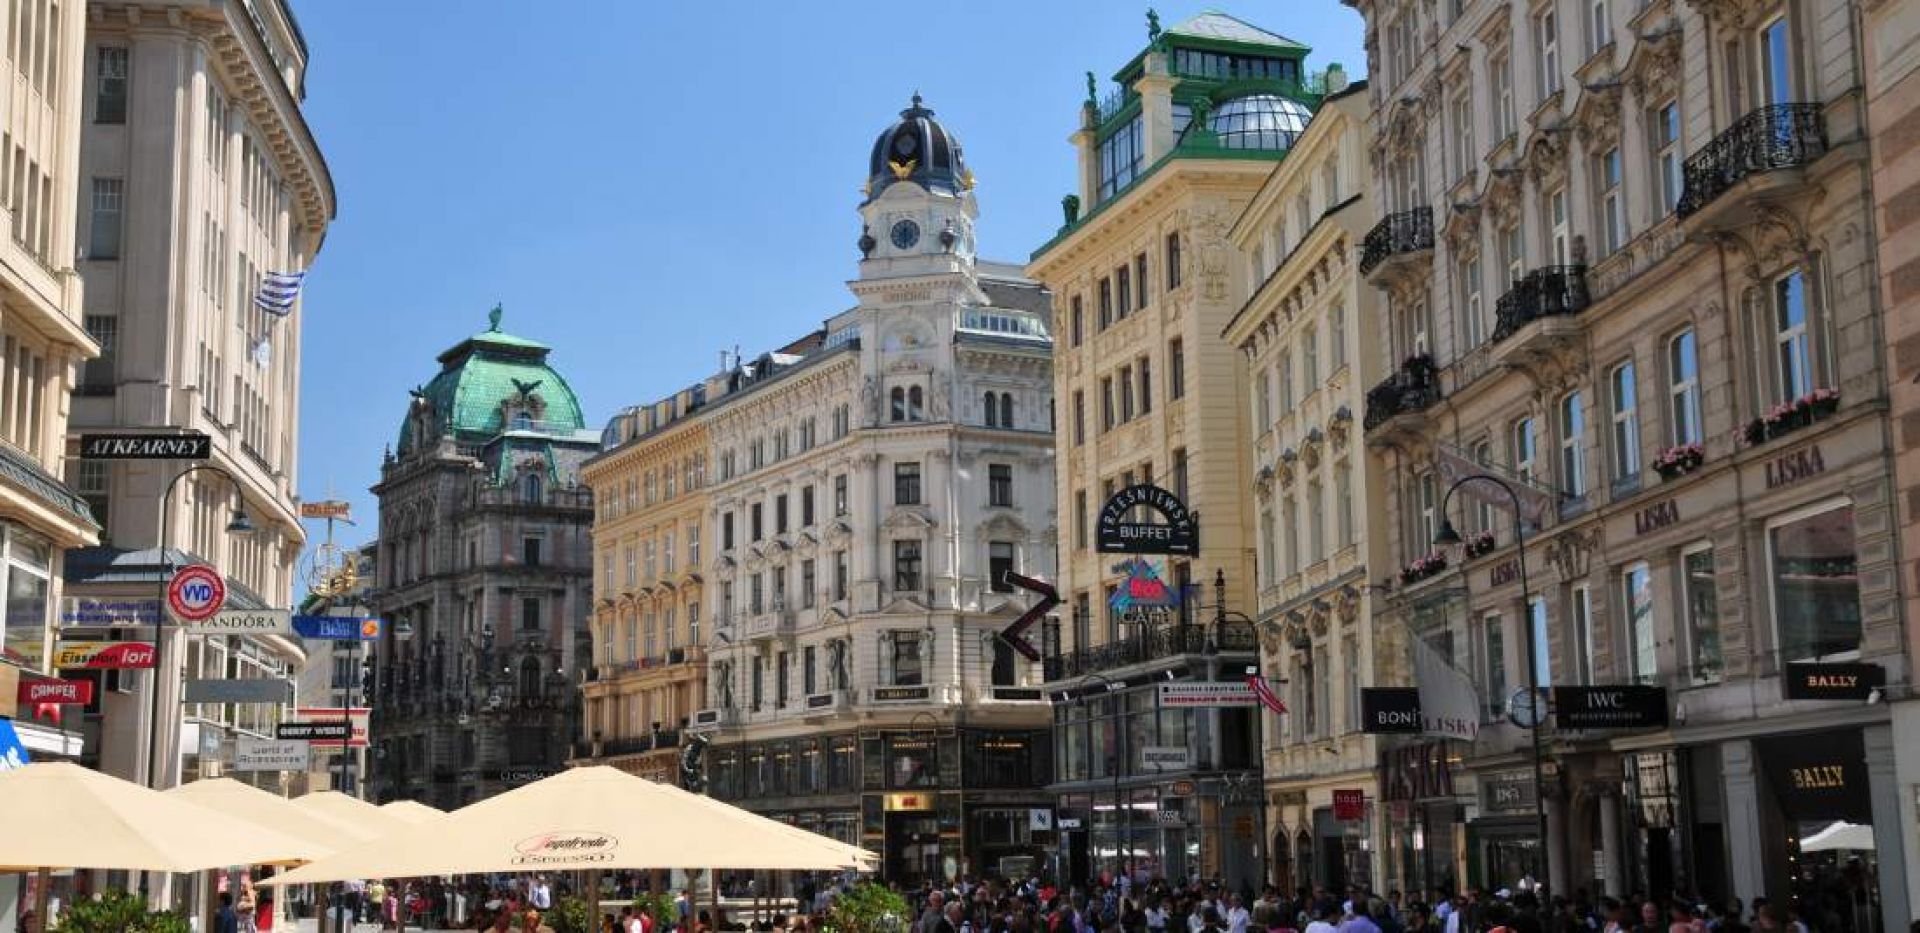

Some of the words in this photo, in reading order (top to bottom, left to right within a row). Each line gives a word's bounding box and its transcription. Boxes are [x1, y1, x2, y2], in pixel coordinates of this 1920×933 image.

[1765, 444, 1825, 489] LISKA
[1635, 498, 1680, 536] LISKA
[1120, 526, 1172, 540] BUFFET
[1490, 558, 1521, 587] LISKA
[1807, 675, 1858, 687] BALLY
[31, 684, 77, 700] CAMPER
[1587, 691, 1623, 708] IWC
[1791, 765, 1844, 788] BALLY
